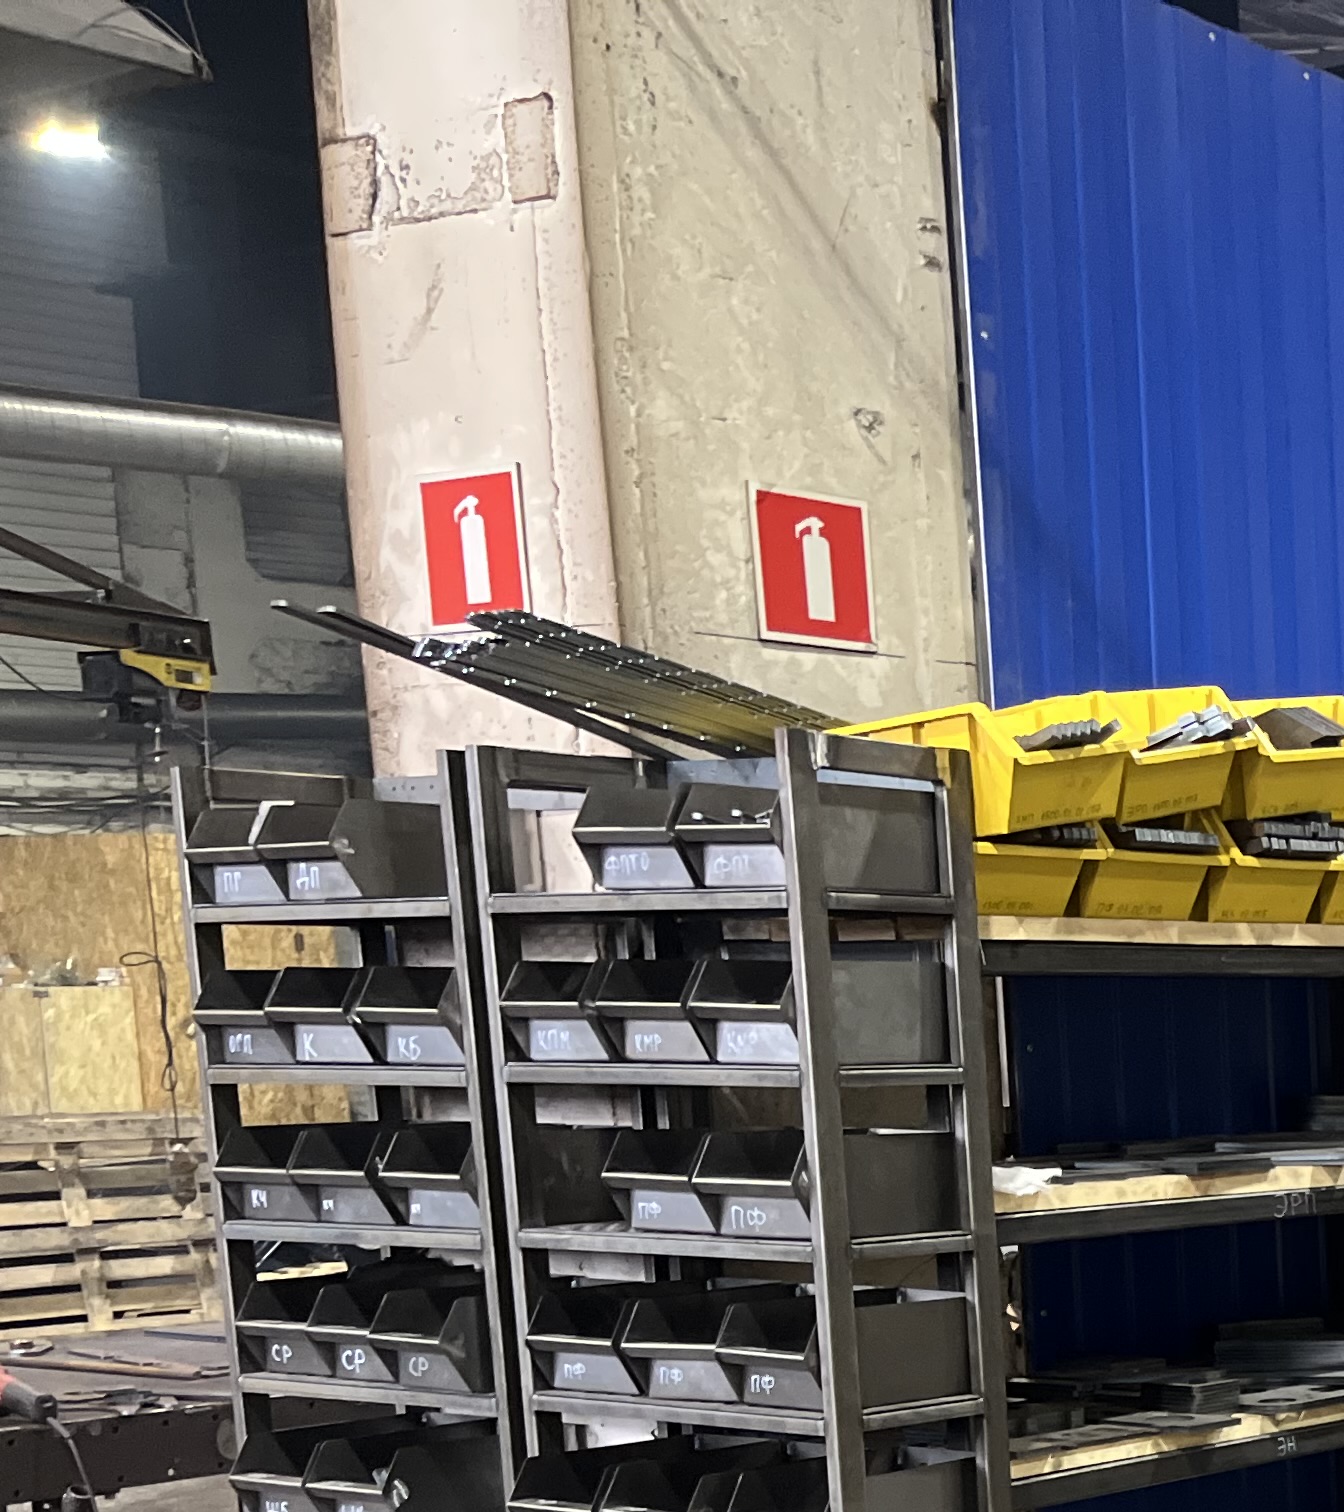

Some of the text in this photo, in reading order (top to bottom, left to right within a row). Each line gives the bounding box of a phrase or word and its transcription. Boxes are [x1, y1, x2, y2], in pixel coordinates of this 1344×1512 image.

[303, 1033, 317, 1060] К
[638, 1200, 662, 1219] ПФ
[1273, 1191, 1317, 1218] ЭРП
[731, 1205, 766, 1232] ПФ
[271, 1344, 293, 1364] СР
[341, 1348, 366, 1373] СР
[408, 1356, 429, 1377] СР
[563, 1362, 586, 1382] ПФ
[659, 1366, 684, 1385] ПФ
[750, 1374, 775, 1395] ПФ
